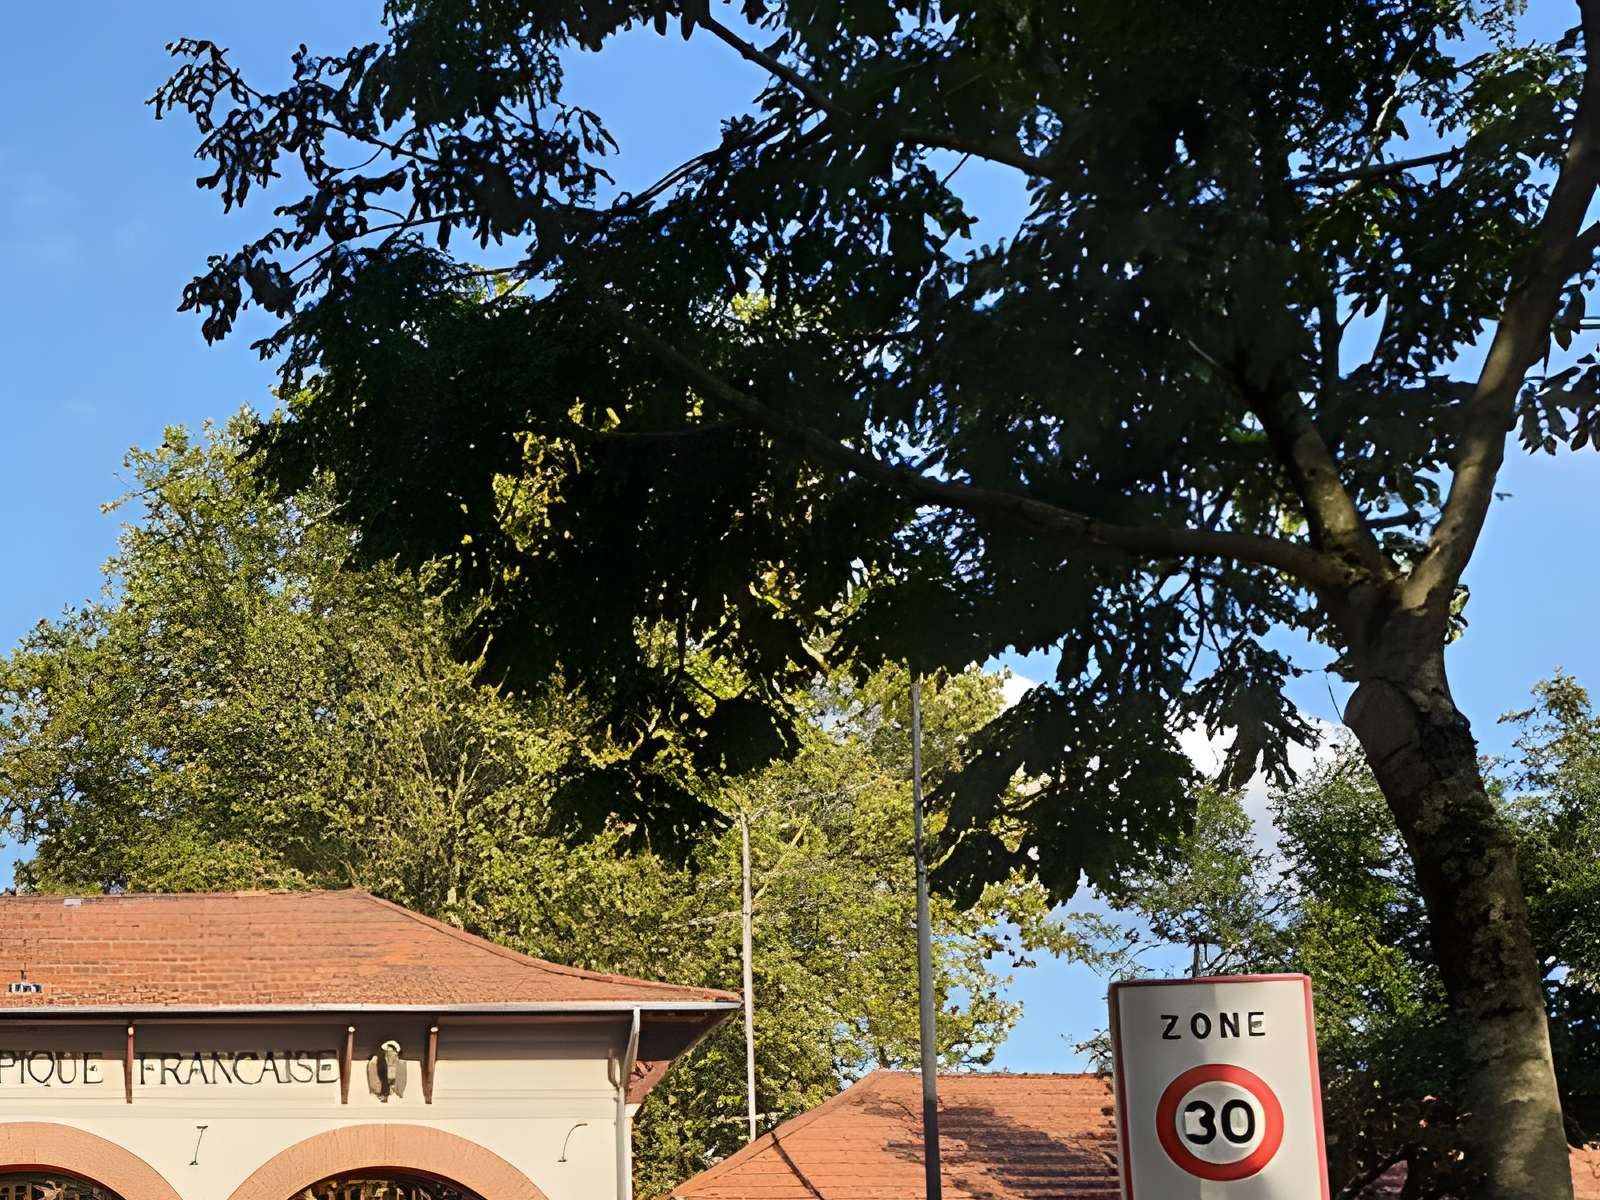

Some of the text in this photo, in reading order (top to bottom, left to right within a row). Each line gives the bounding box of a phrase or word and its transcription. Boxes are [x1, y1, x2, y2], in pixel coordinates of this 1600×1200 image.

[1160, 1011, 1266, 1040] ZONE
[138, 1051, 340, 1085] FRANCAISE
[1184, 1098, 1256, 1145] 30
